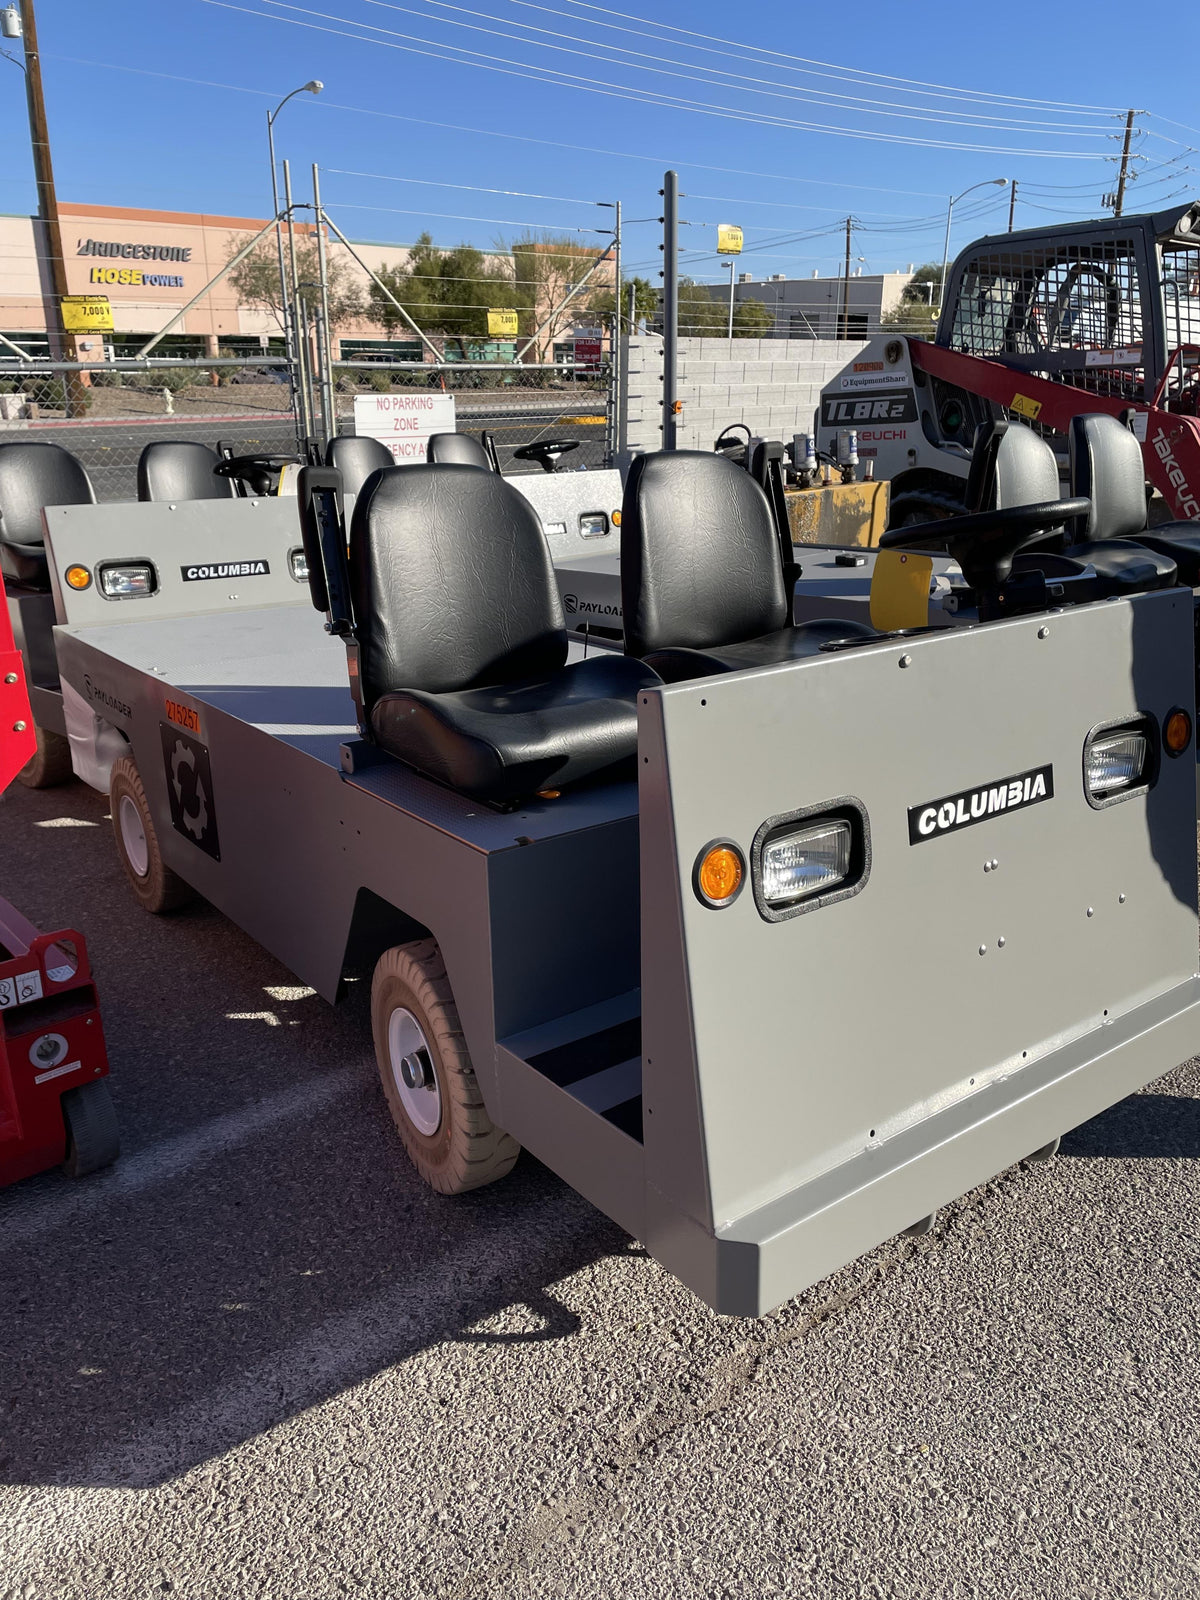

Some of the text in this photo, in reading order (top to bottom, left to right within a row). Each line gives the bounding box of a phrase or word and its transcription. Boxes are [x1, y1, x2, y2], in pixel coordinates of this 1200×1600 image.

[76, 239, 192, 262] BRIDGESTONE
[90, 267, 185, 288] HOSE POWER
[81, 306, 104, 316] 7,000
[849, 375, 906, 387] EquipmentShare
[376, 397, 434, 411] NO PARKING
[393, 417, 419, 431] ZONE
[856, 430, 907, 441] KEUCHI
[187, 562, 265, 579] COLUMBIA
[94, 687, 132, 720] PAYLOADER
[165, 699, 200, 732] 275257
[918, 773, 1047, 835] COLUMBIA
